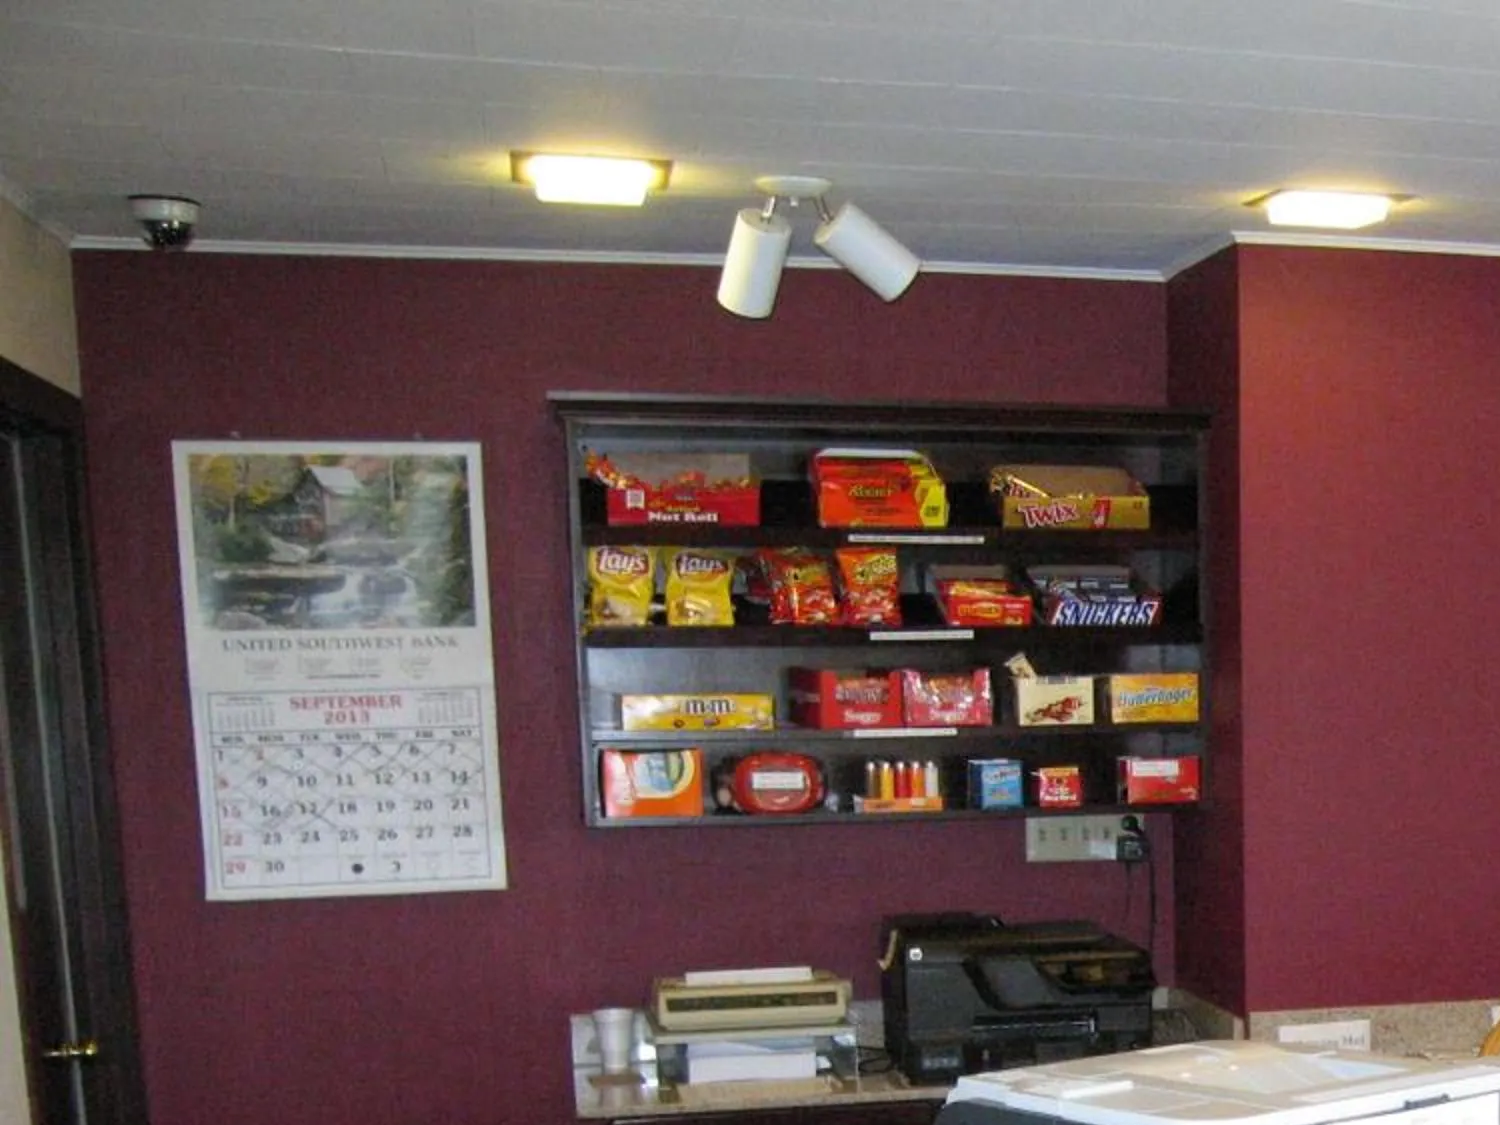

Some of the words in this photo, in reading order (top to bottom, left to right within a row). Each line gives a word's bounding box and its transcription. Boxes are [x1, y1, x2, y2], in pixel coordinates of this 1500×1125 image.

[648, 511, 681, 522] Nut
[684, 511, 719, 522] Roll
[1018, 502, 1080, 529] Twix
[222, 638, 292, 651] UNITED
[297, 636, 404, 650] SOUTHWEST
[412, 635, 459, 648] BANK
[290, 694, 402, 710] SEPTEMBER
[324, 710, 370, 725] 2013
[297, 776, 317, 787] 10
[336, 774, 353, 786] 11
[375, 773, 393, 785] 12
[413, 771, 431, 783] 13
[451, 770, 469, 784] 14
[261, 804, 281, 817] 16
[339, 802, 357, 814] 18
[377, 800, 396, 812] 19
[414, 799, 433, 811] 20
[452, 798, 469, 811] 21
[223, 833, 243, 847] 22
[263, 832, 283, 845] 23
[302, 831, 321, 843] 24
[339, 829, 359, 842] 25
[378, 828, 398, 841] 26
[415, 826, 433, 839] 27
[453, 825, 473, 838] 28
[226, 861, 246, 875] 29
[266, 860, 285, 873] 30
